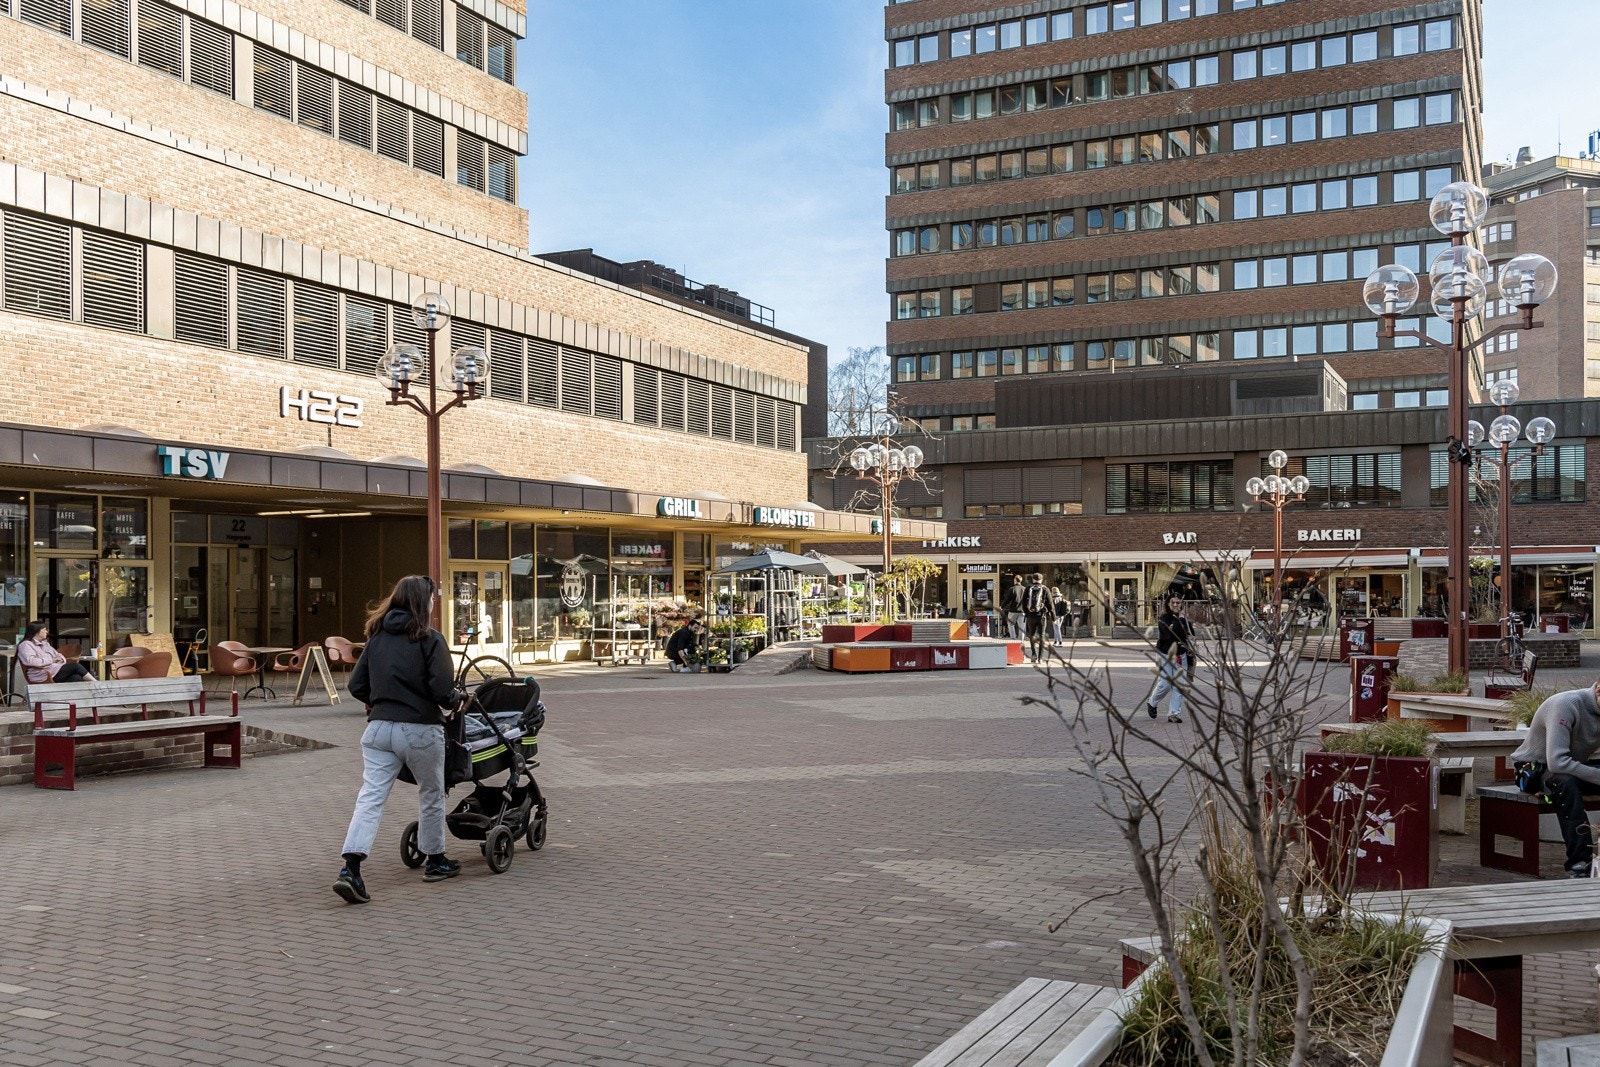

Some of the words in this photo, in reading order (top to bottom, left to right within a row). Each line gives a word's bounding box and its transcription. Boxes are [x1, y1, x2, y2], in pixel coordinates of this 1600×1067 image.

[280, 385, 364, 428] H22
[163, 446, 230, 479] TSV
[662, 496, 703, 518] GRILL
[56, 511, 75, 520] KAFFE
[758, 506, 816, 528] BLOMSTER
[115, 526, 134, 534] PLASS
[231, 519, 246, 532] 22
[1162, 531, 1198, 545] BAR
[1297, 528, 1362, 542] BAKERI
